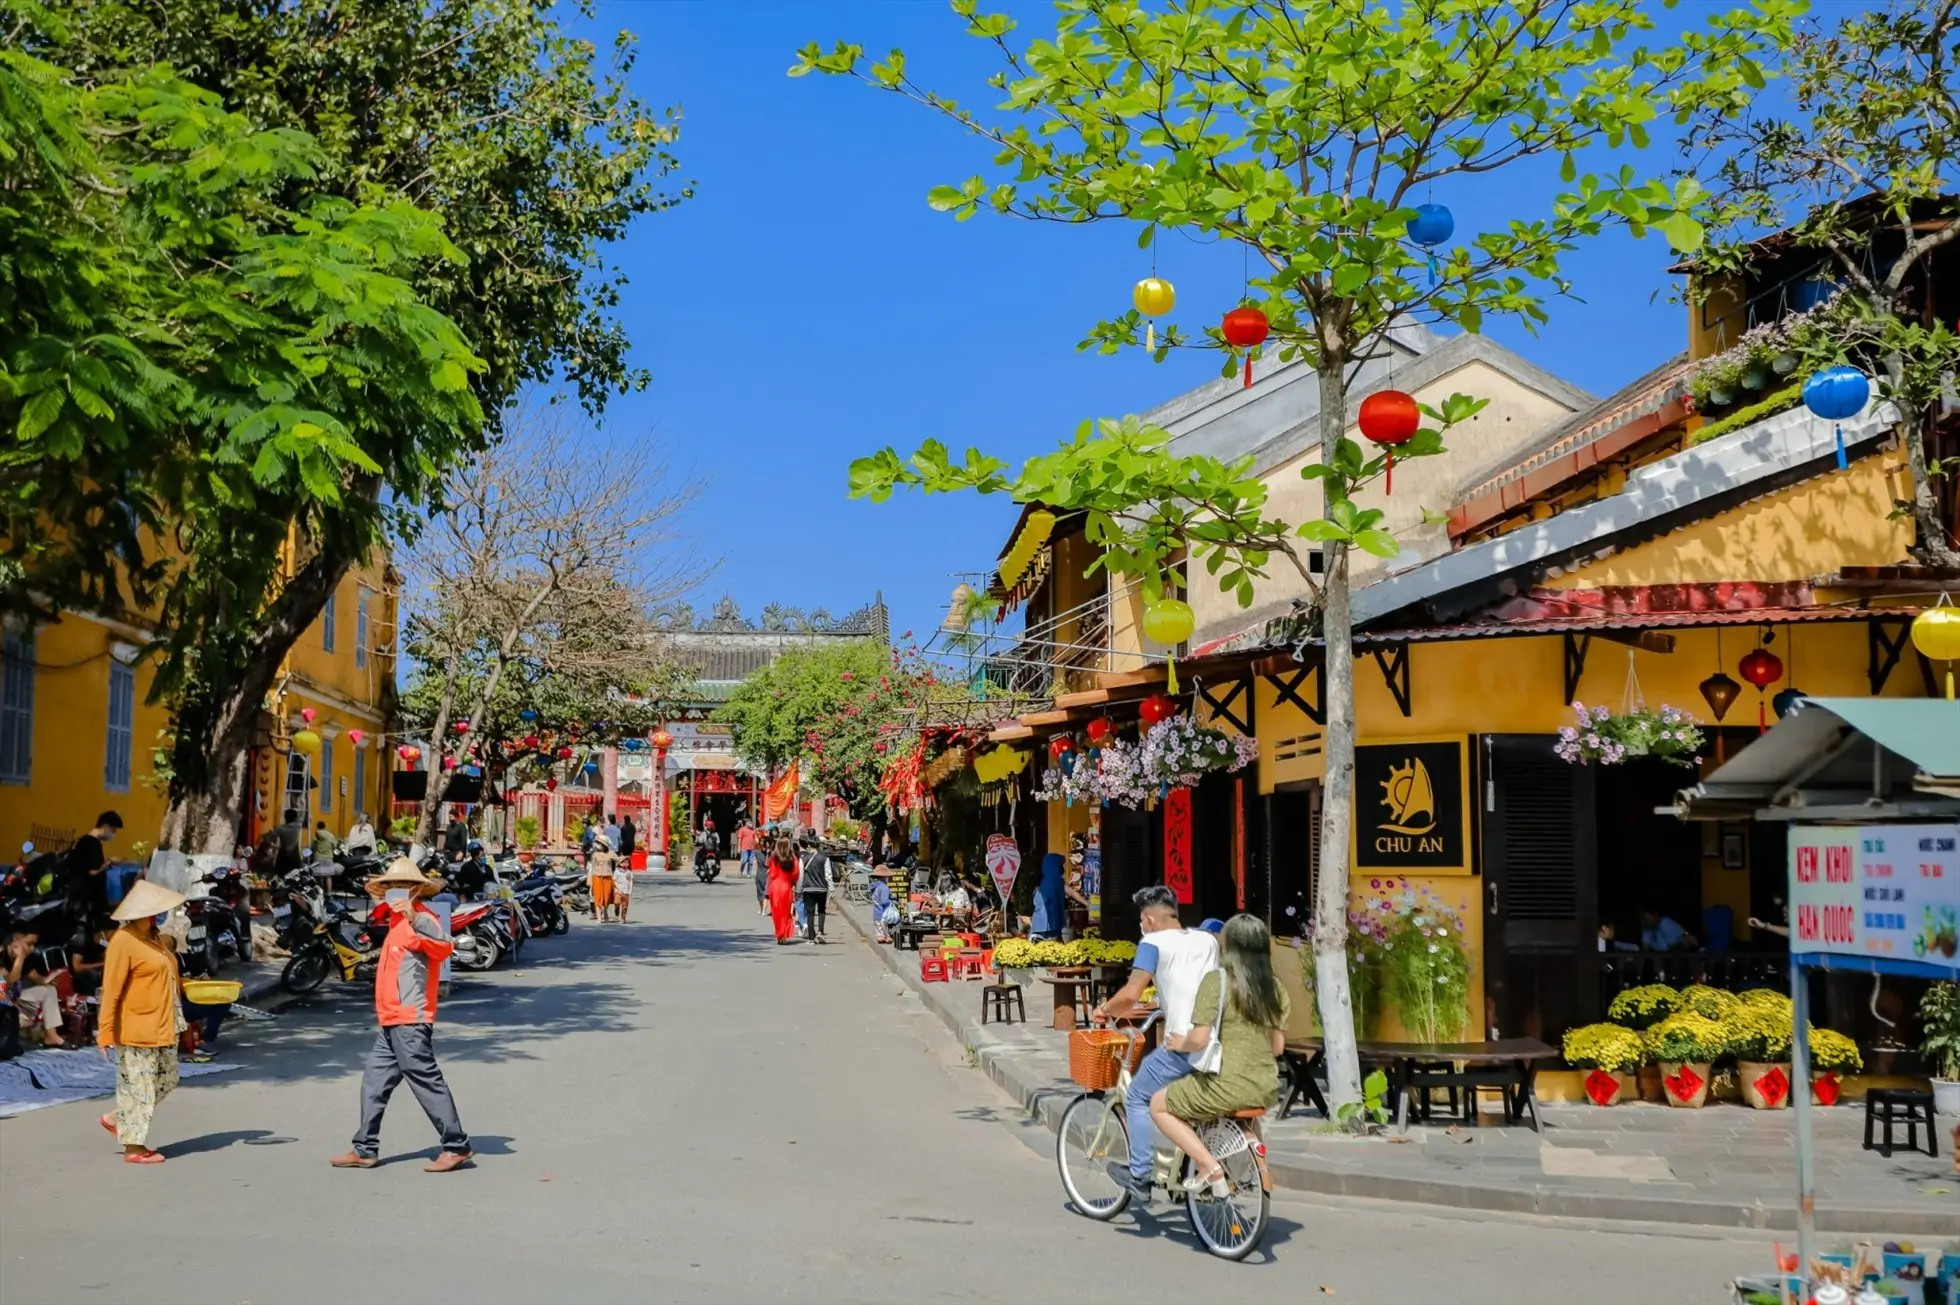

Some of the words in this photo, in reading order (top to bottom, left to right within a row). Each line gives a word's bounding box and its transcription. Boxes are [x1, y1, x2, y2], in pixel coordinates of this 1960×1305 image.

[1375, 837, 1412, 853] CHU
[1418, 837, 1444, 853] AN
[1797, 846, 1819, 883] KEM
